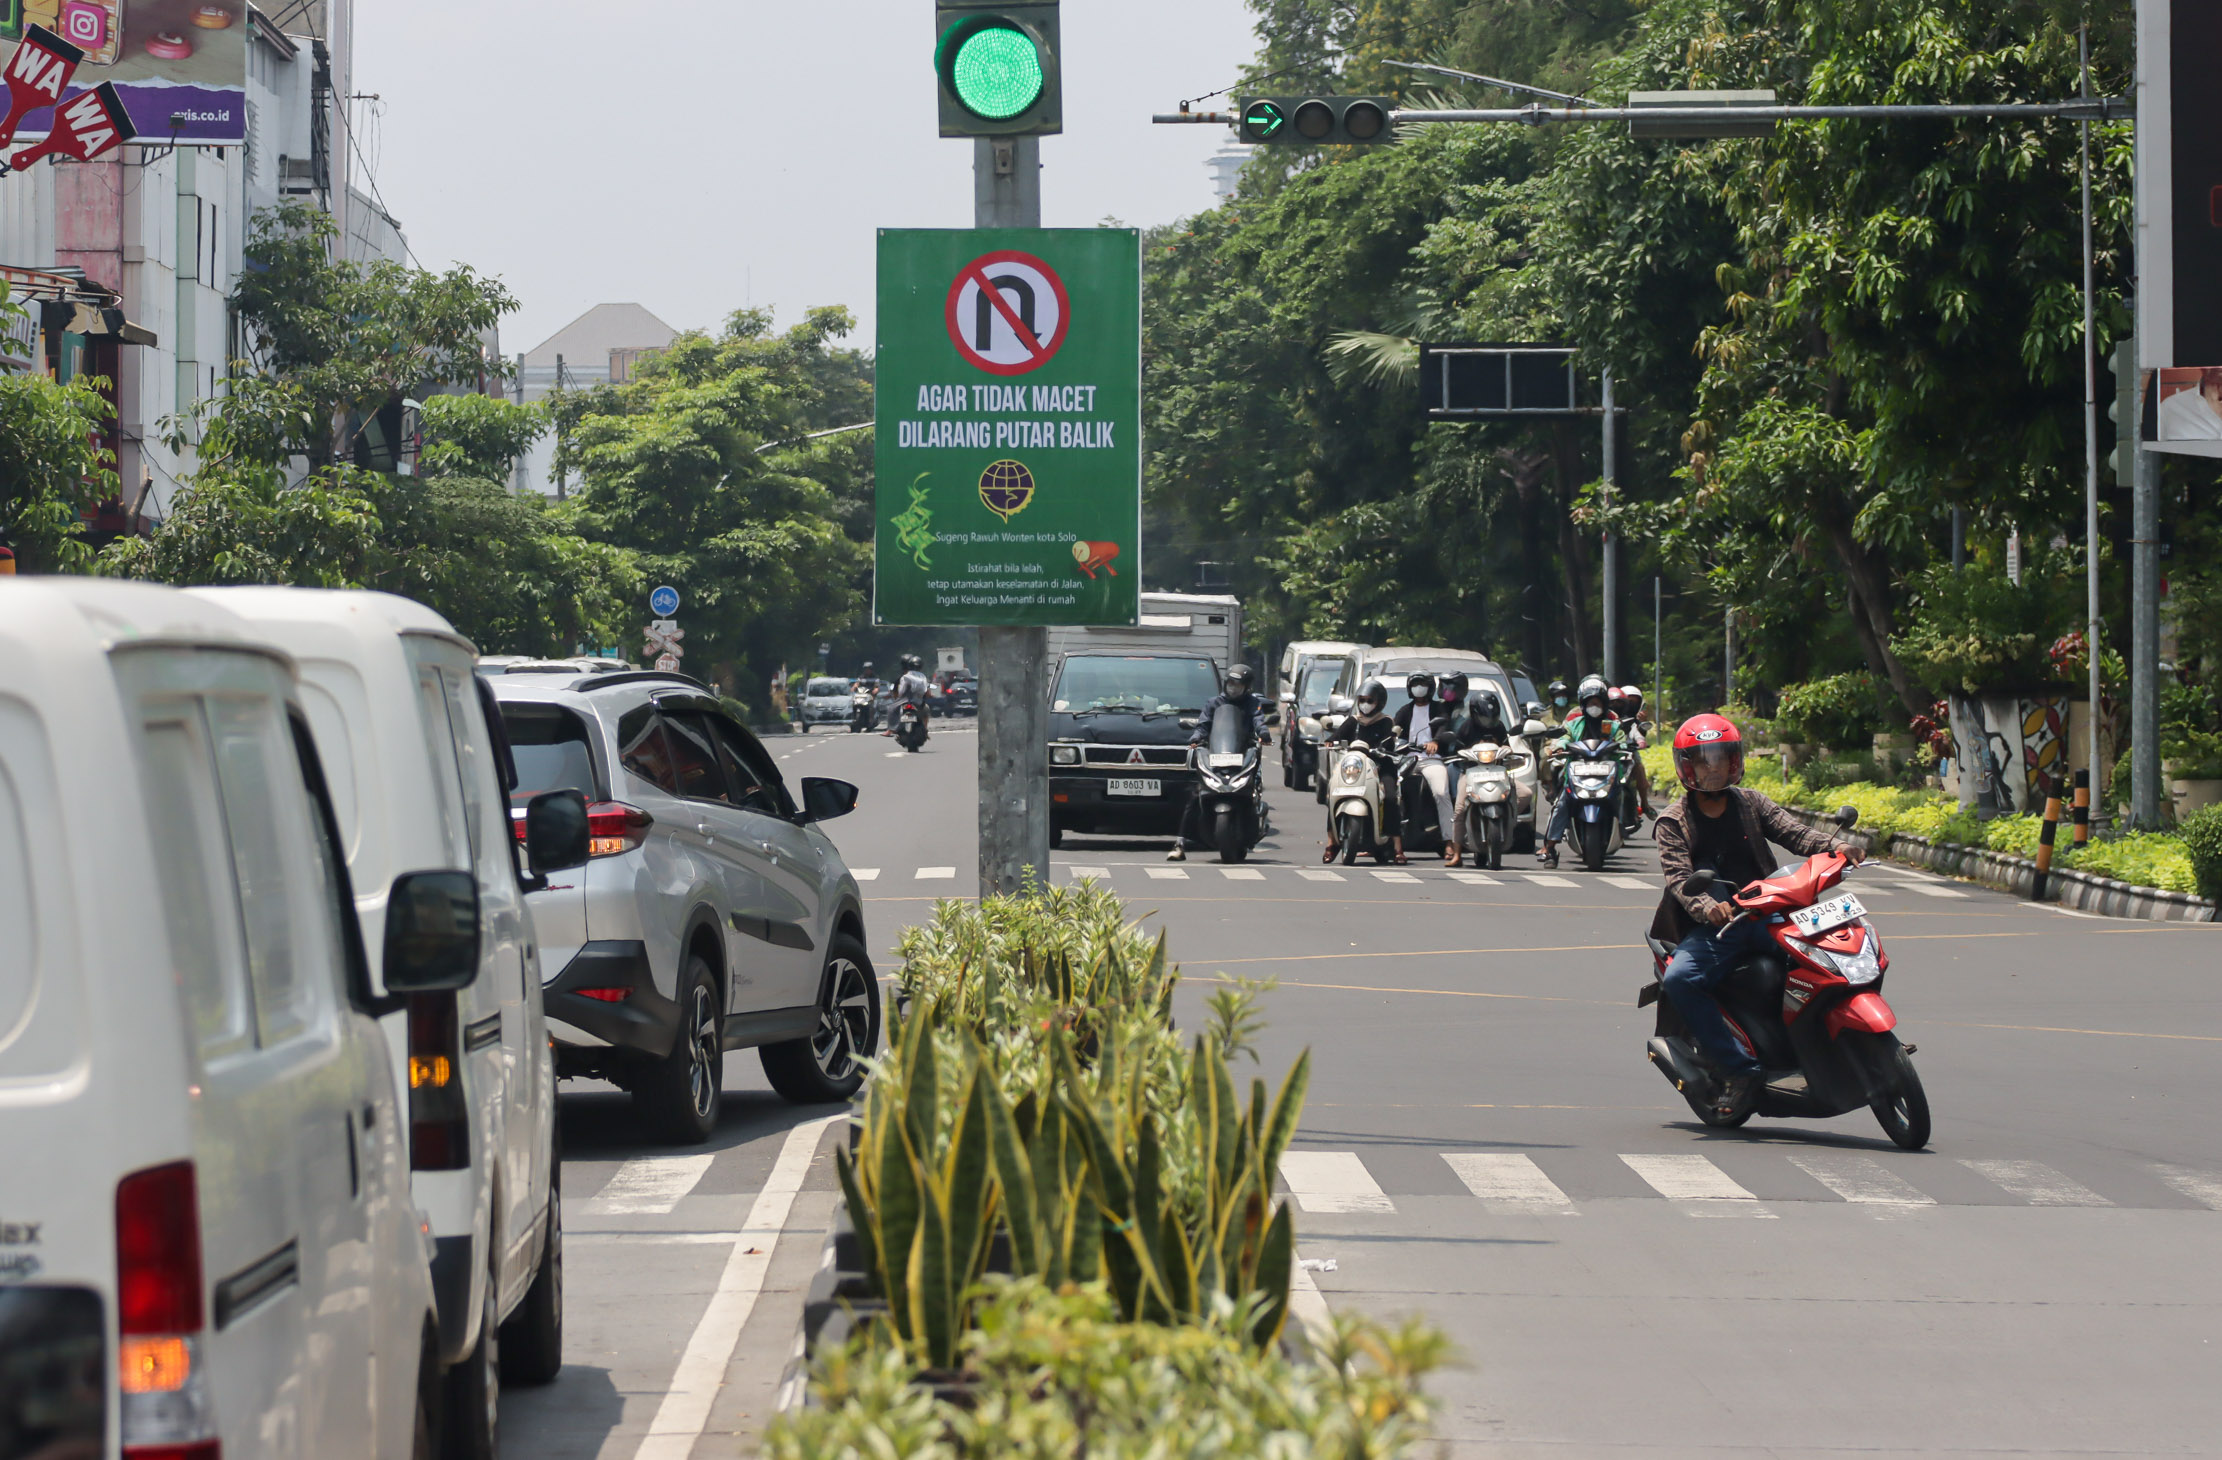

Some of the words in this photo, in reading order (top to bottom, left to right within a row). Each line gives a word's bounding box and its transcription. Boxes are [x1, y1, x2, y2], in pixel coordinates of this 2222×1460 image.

[13, 42, 66, 99] WA
[64, 92, 114, 158] WA
[917, 384, 967, 412] AGAR
[972, 385, 1027, 412] TIDAK
[1032, 385, 1096, 412] MACET
[899, 421, 991, 448] DILARANG
[996, 421, 1055, 448] PUTAR
[1060, 422, 1115, 448] BALIK
[935, 532, 968, 544] Sugeng
[971, 532, 999, 542] Rawuh
[1001, 532, 1035, 542] Wonten
[1037, 532, 1056, 542] kota
[1058, 532, 1077, 542] Solo
[967, 563, 1002, 573] Istirahat
[1004, 563, 1020, 573] bila
[1022, 563, 1044, 574] lelah,
[927, 580, 949, 591] tetap
[952, 579, 994, 589] utamakan
[996, 579, 1049, 589] keselamatan
[1050, 579, 1059, 589] di
[1061, 579, 1085, 590] Jalan,
[936, 595, 958, 606] Ingat
[961, 595, 998, 606] Keluarga
[1000, 595, 1035, 604] Menanti
[1037, 595, 1046, 604] di
[1048, 595, 1076, 604] rumah
[1110, 781, 1120, 789] AD
[1123, 781, 1144, 790] 8603
[1148, 781, 1159, 790] VA
[1795, 912, 1809, 925] AD
[1810, 902, 1837, 916] 5349
[1789, 976, 1814, 989] HONDA
